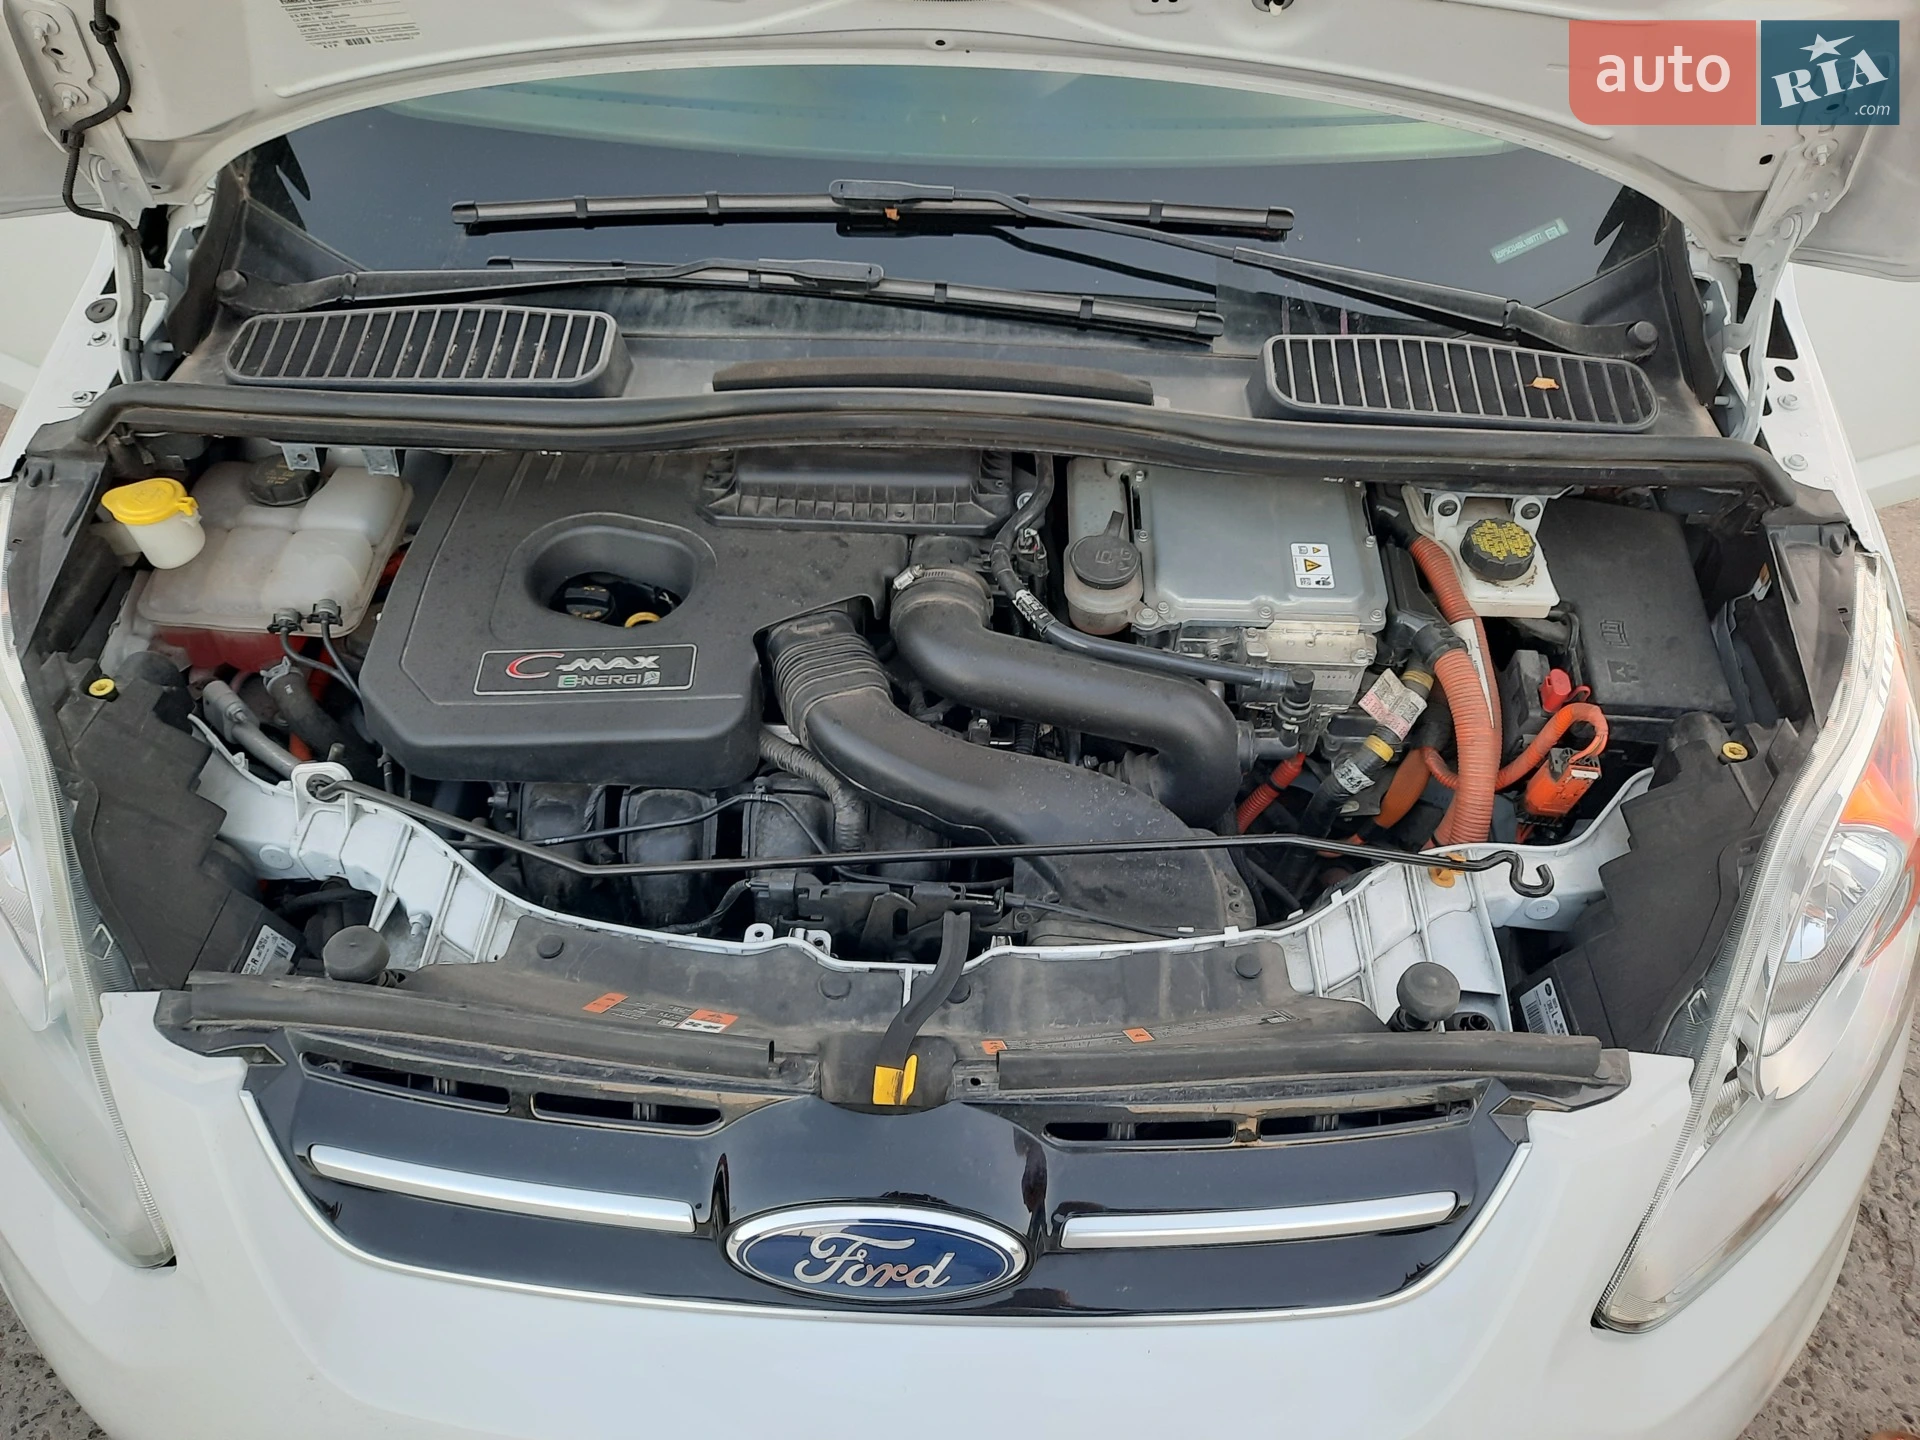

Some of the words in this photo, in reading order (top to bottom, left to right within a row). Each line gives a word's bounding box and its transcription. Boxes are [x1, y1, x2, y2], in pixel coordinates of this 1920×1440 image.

[505, 652, 660, 679] C-MAX
[557, 674, 643, 688] ENERGI
[794, 1232, 956, 1289] Ford
